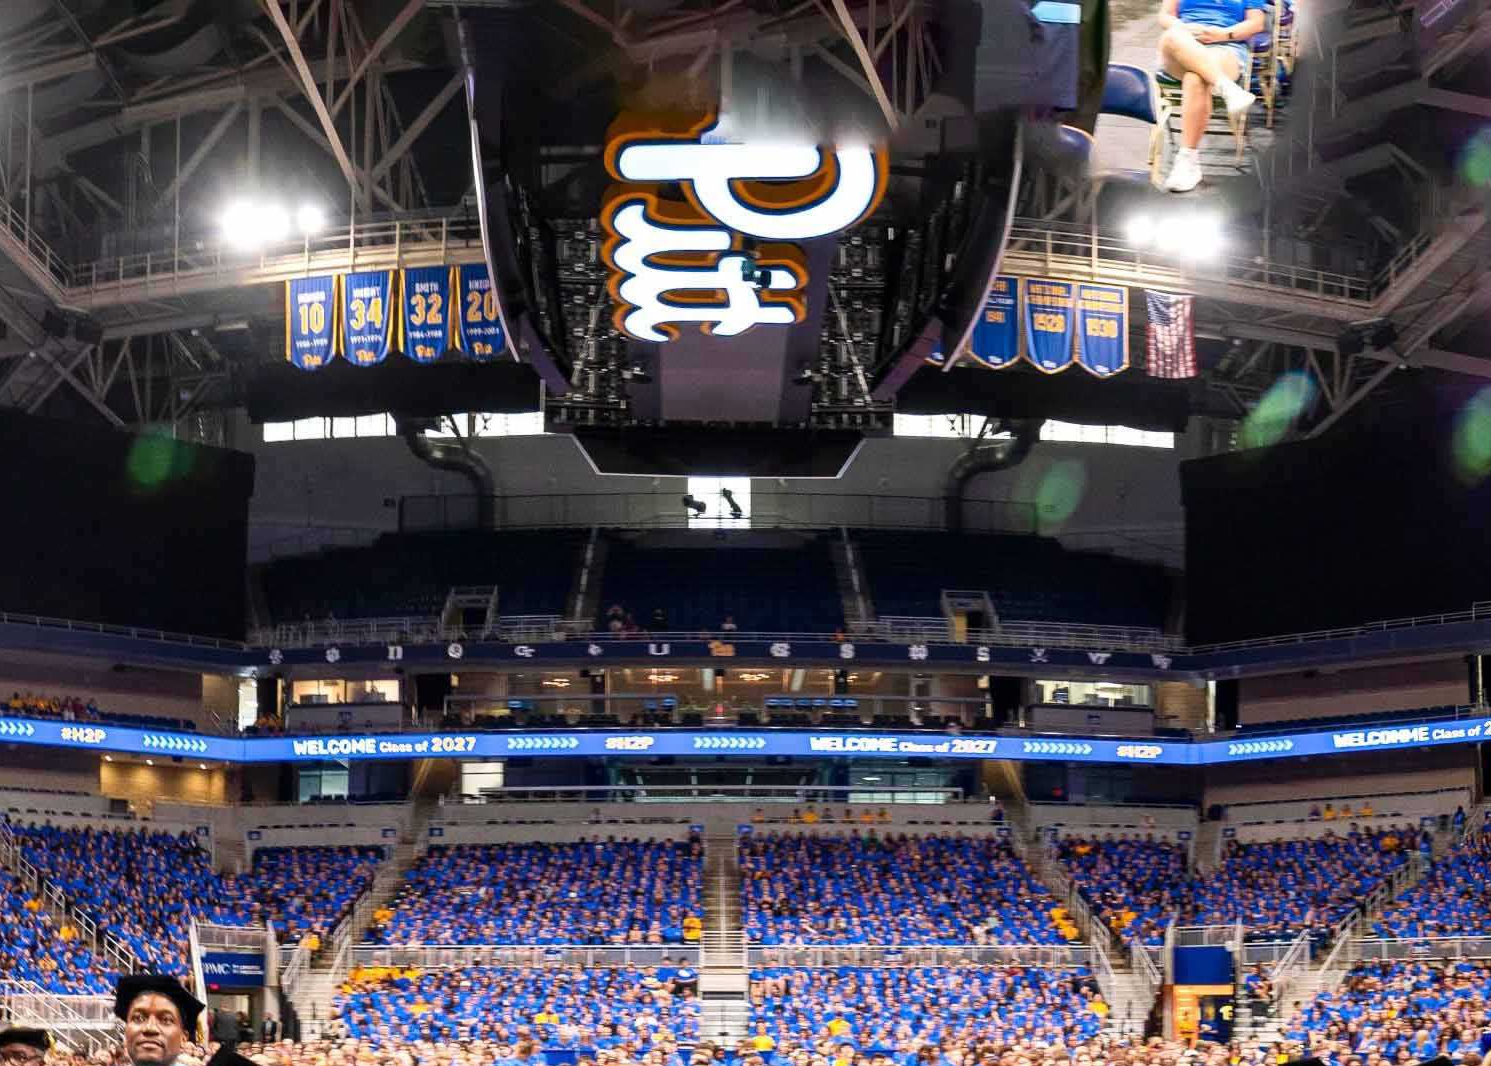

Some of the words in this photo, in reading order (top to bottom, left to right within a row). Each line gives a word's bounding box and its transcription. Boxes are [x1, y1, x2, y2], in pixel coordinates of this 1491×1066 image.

[604, 120, 889, 342] Pitt
[299, 303, 325, 335] 10
[349, 297, 383, 330] 34
[410, 293, 443, 326] 32
[466, 290, 498, 322] 20
[61, 726, 107, 744] #H2P
[293, 738, 377, 756] WELCOME
[379, 741, 413, 753] Class
[414, 740, 429, 753] of
[430, 736, 477, 753] 2027
[809, 736, 899, 752] WELCOME
[1432, 728, 1467, 741] Class
[1467, 725, 1483, 738] of
